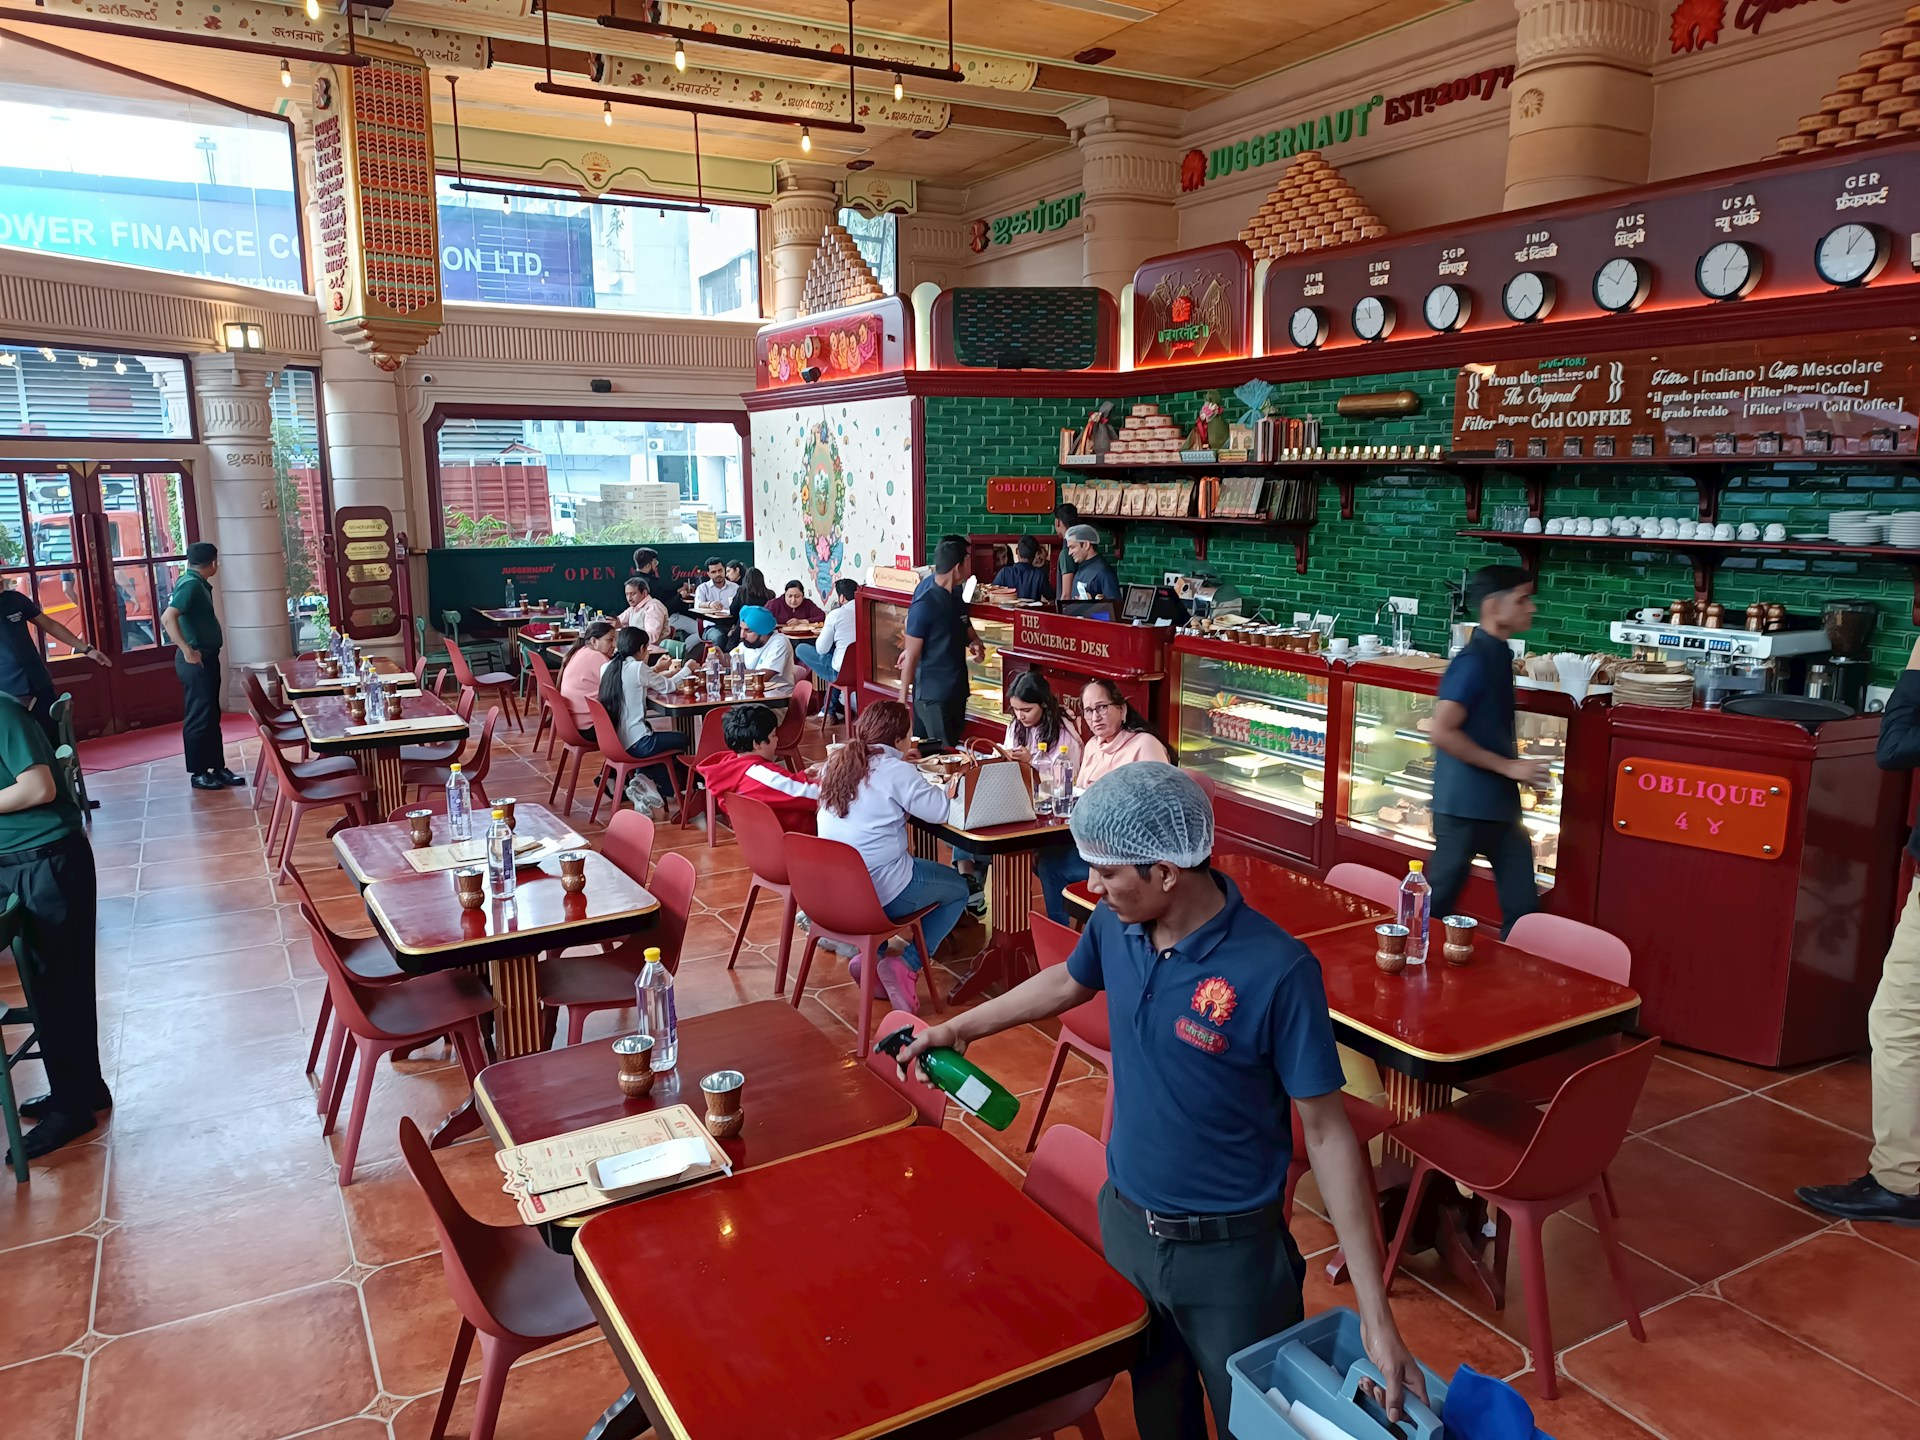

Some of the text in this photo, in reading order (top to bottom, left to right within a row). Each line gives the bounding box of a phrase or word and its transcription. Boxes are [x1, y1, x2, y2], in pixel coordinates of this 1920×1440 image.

[1205, 102, 1372, 180] JUGGERNAUT
[1844, 172, 1881, 189] GER
[1722, 194, 1756, 211] USA
[1615, 213, 1645, 230] AUS
[110, 221, 256, 257] FINANCE
[1526, 231, 1550, 245] IND
[1442, 247, 1466, 260] SGP
[494, 249, 550, 277] LTD.
[1368, 260, 1391, 273] ENG
[1488, 372, 1518, 387] From
[1519, 370, 1537, 385] the
[1585, 364, 1601, 380] of
[1801, 358, 1884, 377] Mescolare
[1501, 383, 1583, 413] The Original
[1822, 399, 1852, 413] Cold
[1460, 408, 1632, 432] Filter Degree Cold COFFEE
[995, 483, 1047, 493] OBLIQUE
[501, 566, 554, 575] JUGGERNAUT
[564, 567, 616, 581] OPEN
[1020, 614, 1040, 629] THE
[1020, 630, 1110, 658] CONCIERGE DESK
[1637, 773, 1767, 808] OBLIQUE
